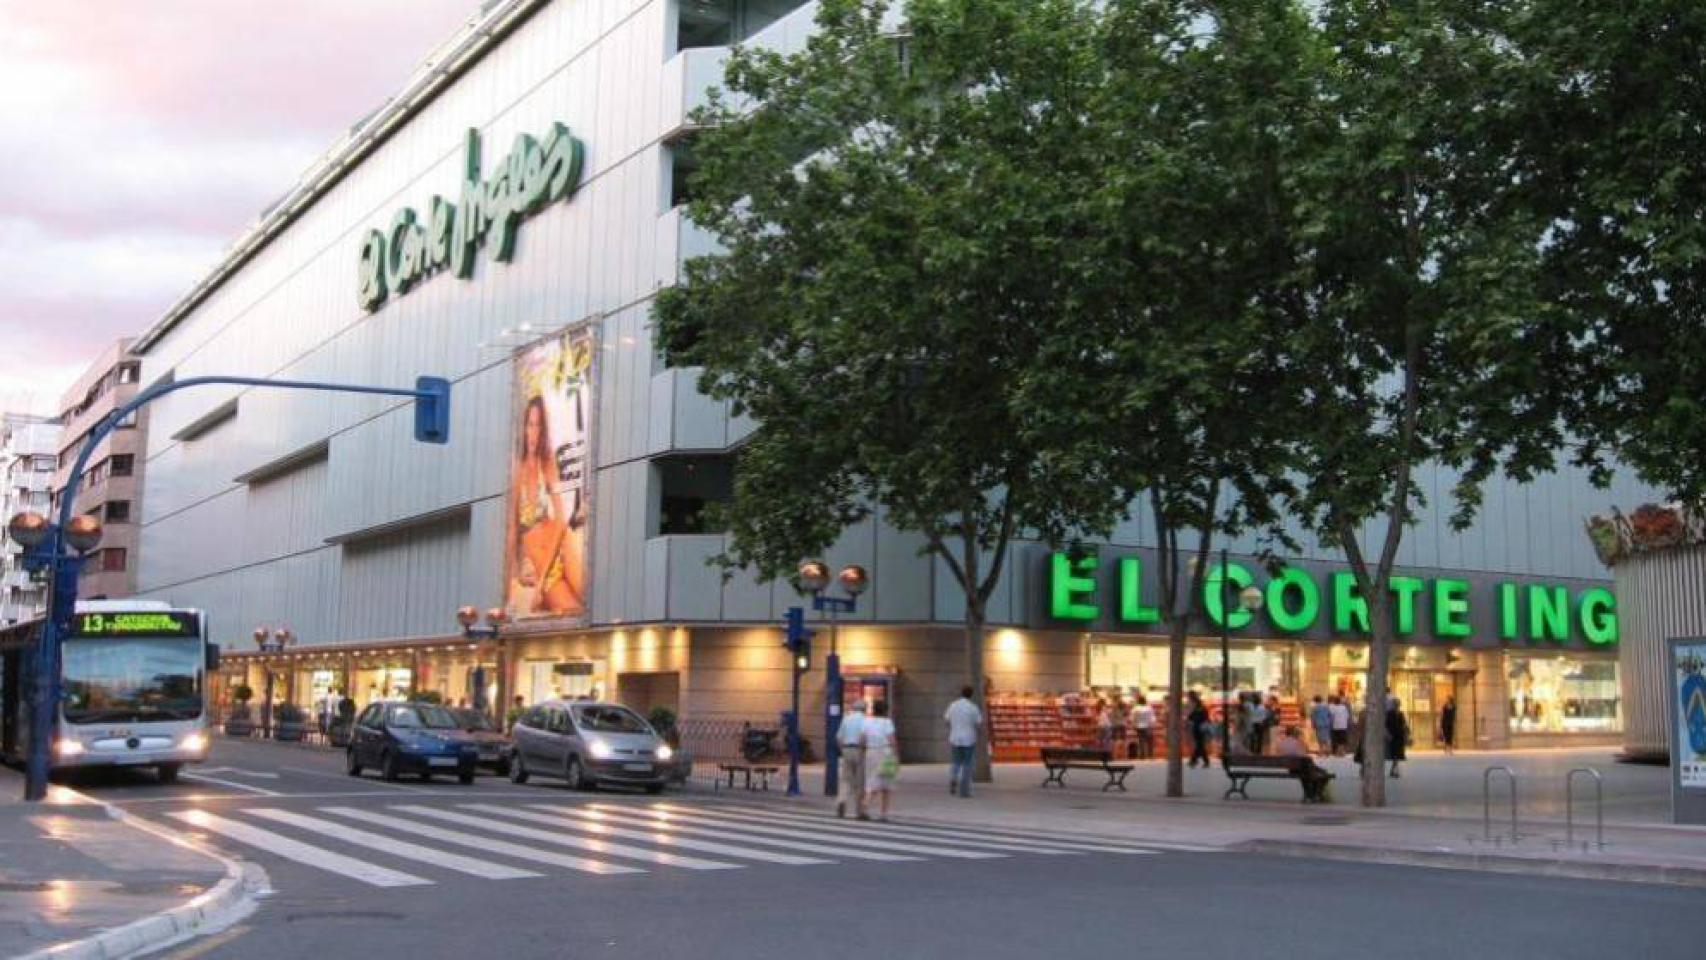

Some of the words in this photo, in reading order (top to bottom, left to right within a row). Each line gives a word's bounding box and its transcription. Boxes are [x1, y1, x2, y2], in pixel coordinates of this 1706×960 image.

[386, 195, 456, 295] Corte
[83, 614, 104, 633] 13
[1051, 552, 1160, 622] EL
[1204, 561, 1471, 636] CORTE
